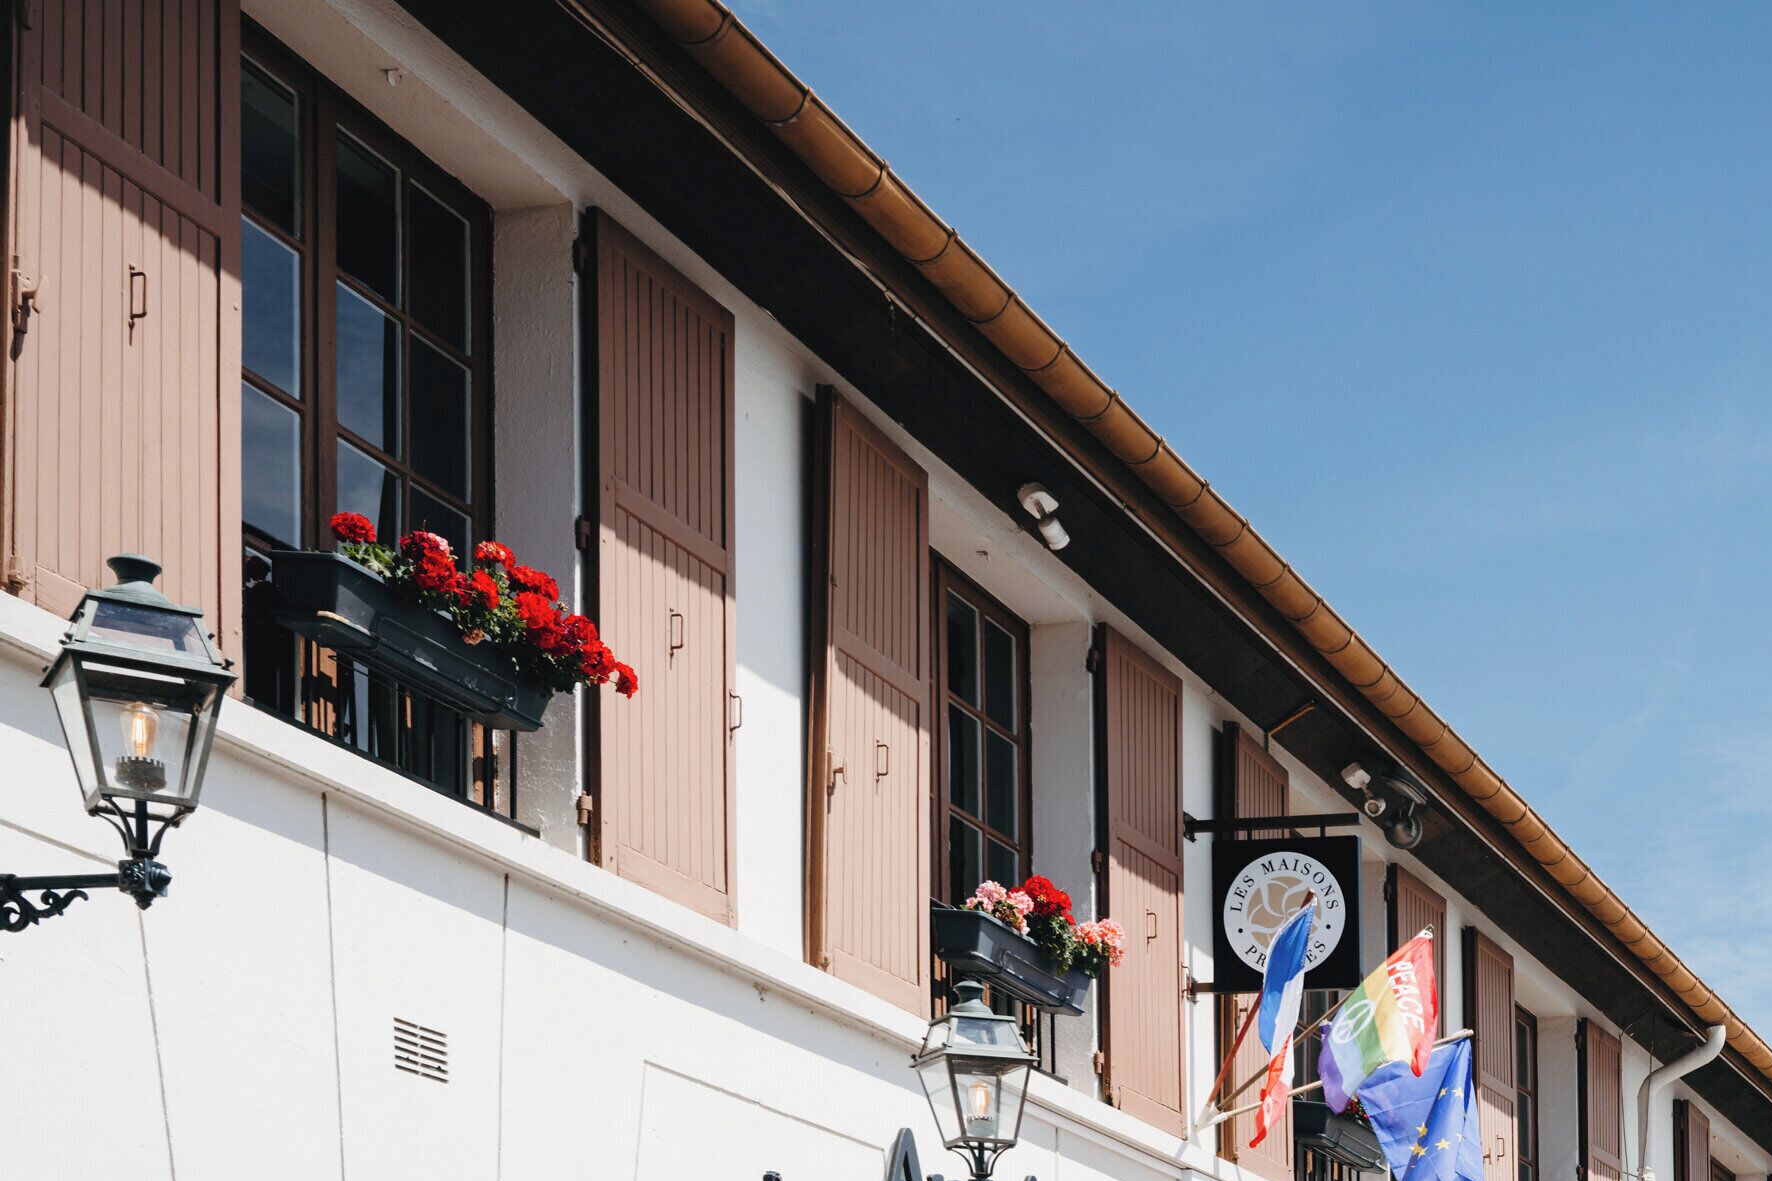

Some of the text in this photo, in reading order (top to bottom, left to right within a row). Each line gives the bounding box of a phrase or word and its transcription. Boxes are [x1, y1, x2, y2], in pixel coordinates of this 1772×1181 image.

[1230, 858, 1339, 913] LES MAISONS
[1244, 940, 1327, 968] PRES
[1387, 961, 1425, 1035] PEACE
